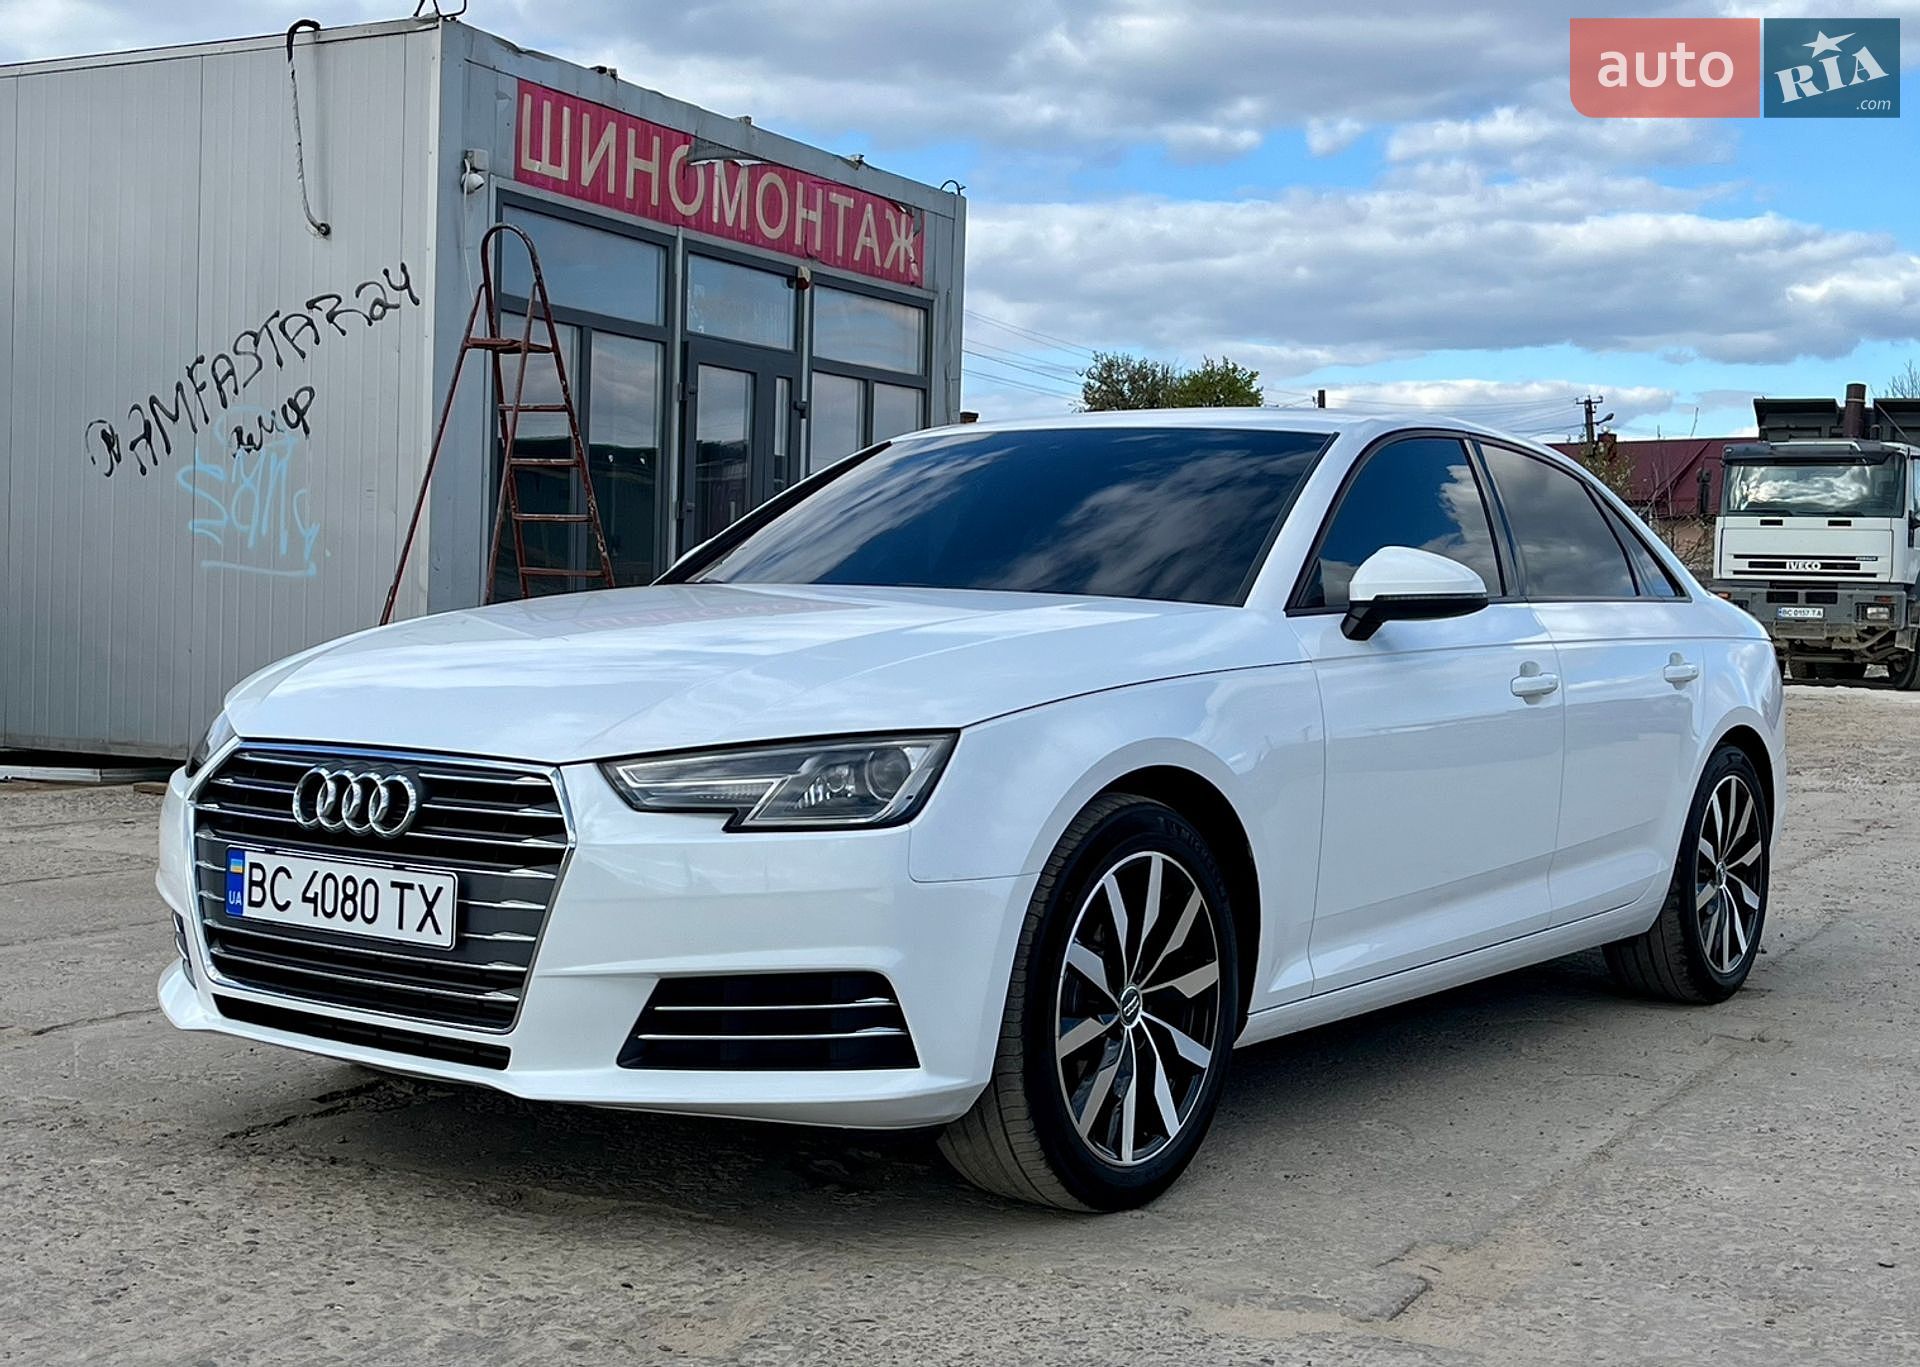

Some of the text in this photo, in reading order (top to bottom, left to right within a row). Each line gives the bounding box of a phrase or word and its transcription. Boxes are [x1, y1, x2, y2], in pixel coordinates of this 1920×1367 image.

[520, 93, 920, 277] ШИНОМОНТАЖ
[1785, 561, 1821, 570] IVECO
[228, 890, 242, 906] UA
[247, 861, 444, 935] BC 4080 TX
